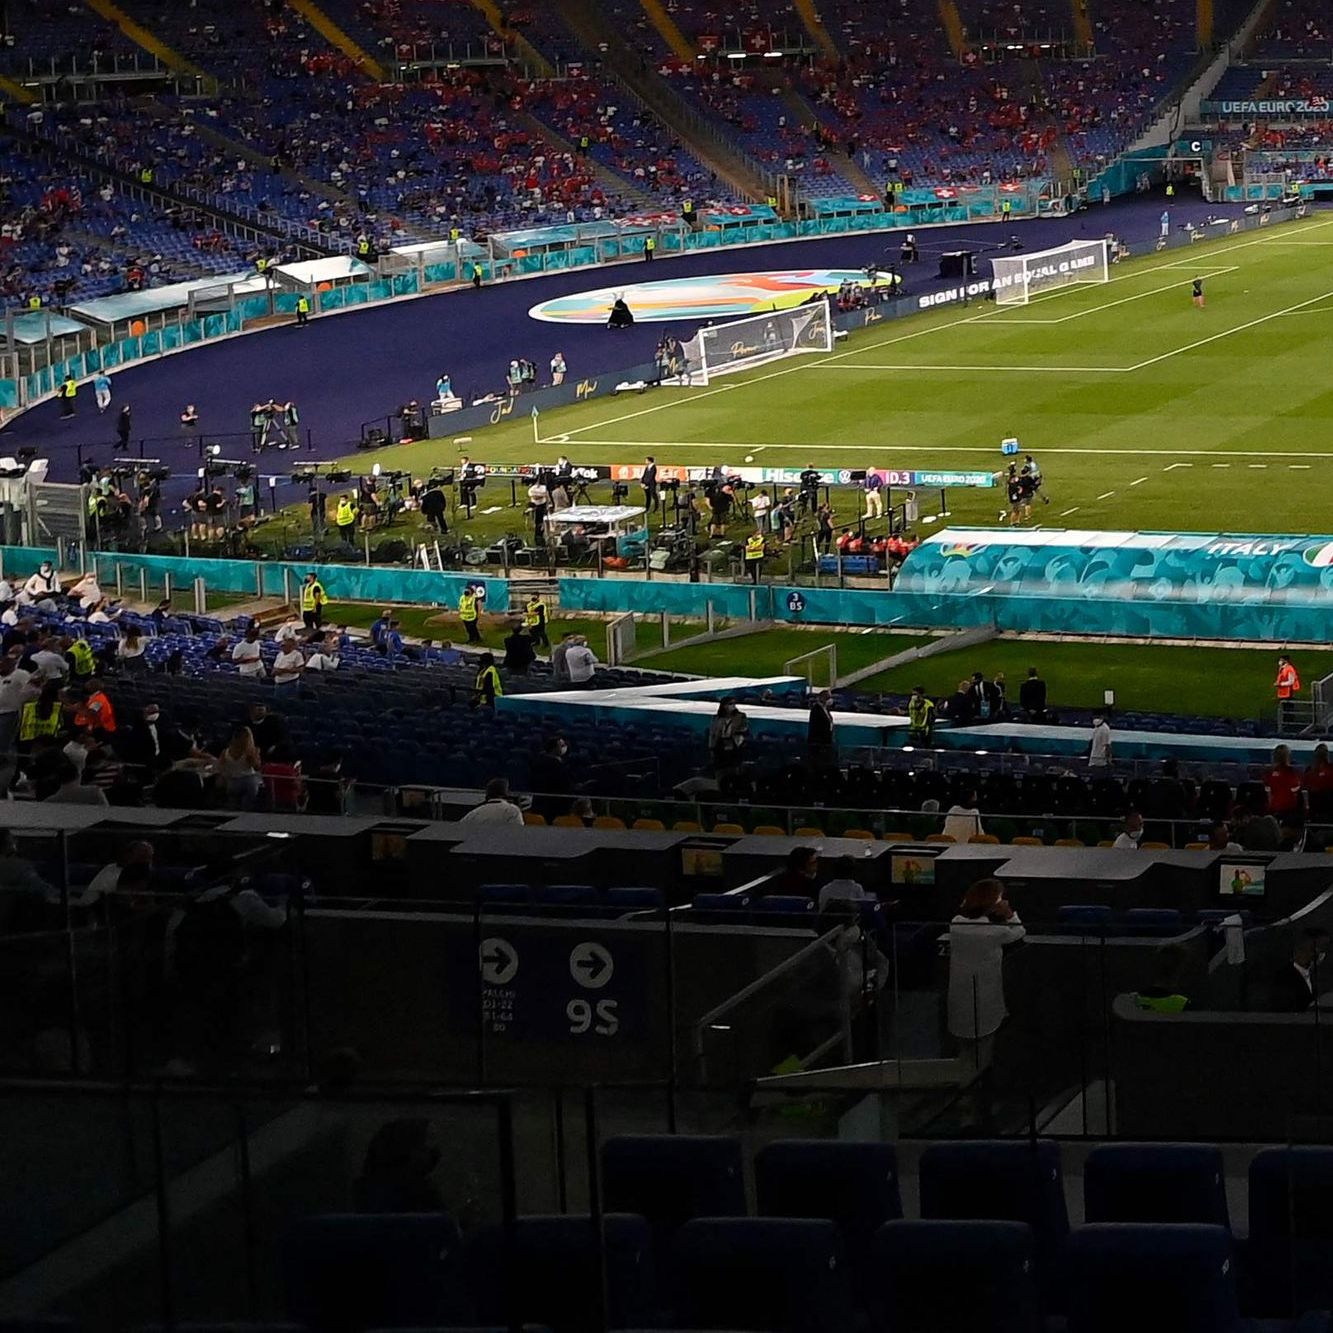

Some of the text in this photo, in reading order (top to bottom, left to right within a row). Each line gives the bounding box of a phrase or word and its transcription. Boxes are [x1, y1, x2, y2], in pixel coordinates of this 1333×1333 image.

[1222, 102, 1257, 113] UEFA
[1260, 102, 1295, 113] EURO
[1191, 141, 1201, 152] C
[919, 288, 958, 308] SIGN
[992, 275, 1012, 289] AN
[886, 472, 911, 485] ID.3
[922, 473, 941, 483] UEFA
[1207, 543, 1292, 555] ITALY
[793, 592, 799, 602] 3
